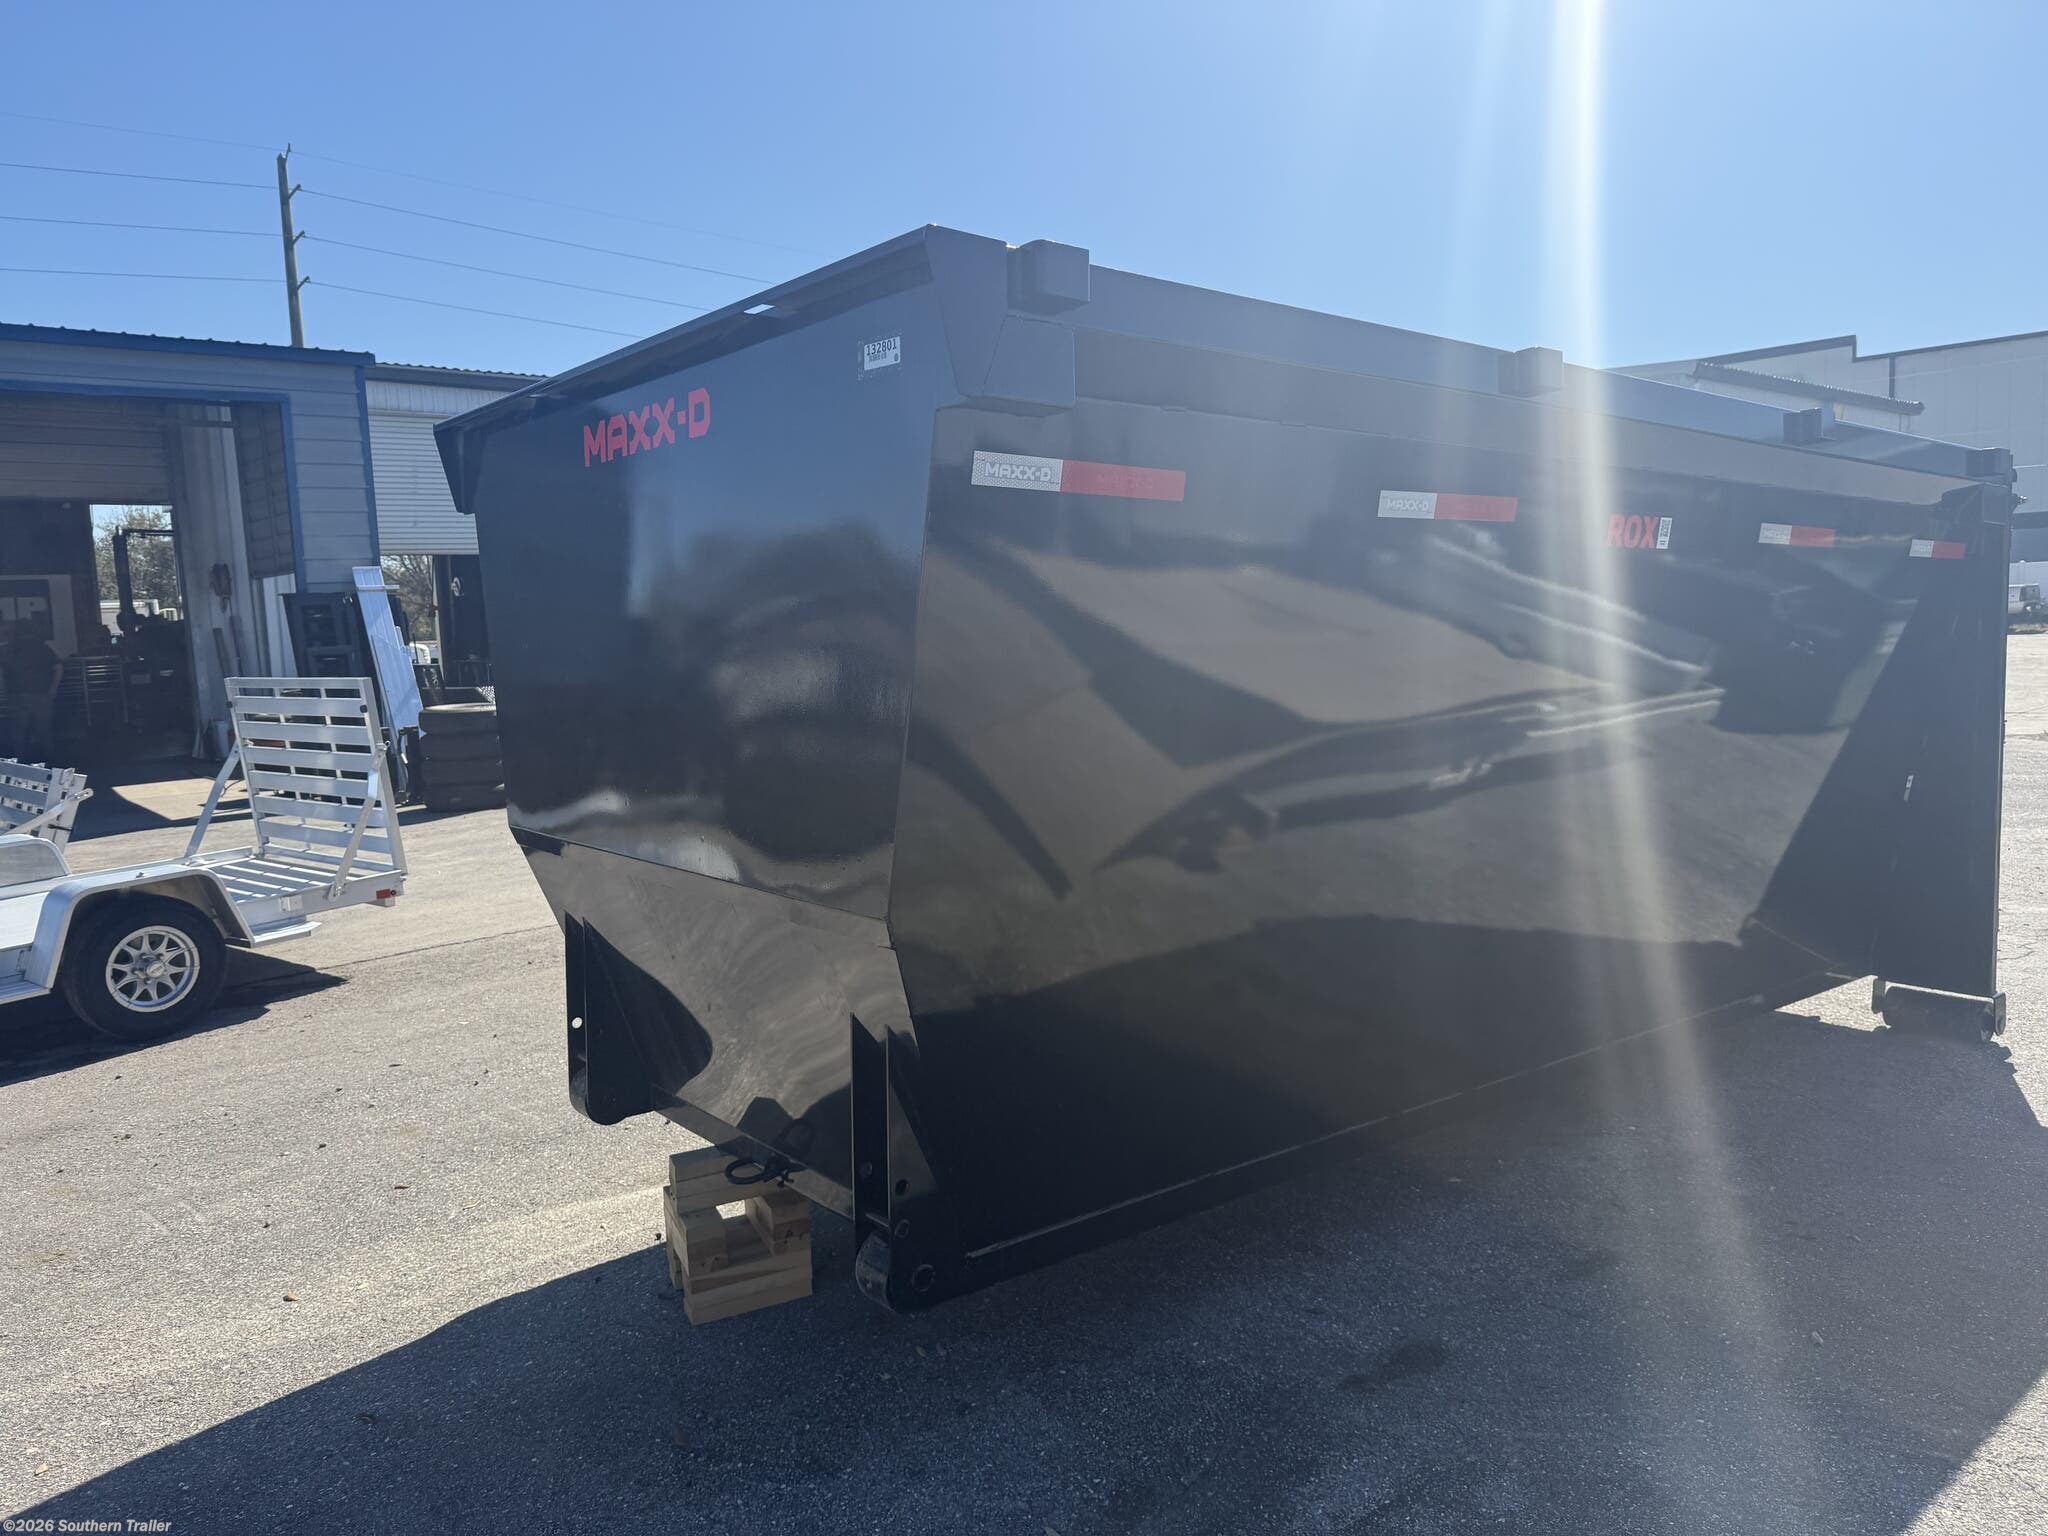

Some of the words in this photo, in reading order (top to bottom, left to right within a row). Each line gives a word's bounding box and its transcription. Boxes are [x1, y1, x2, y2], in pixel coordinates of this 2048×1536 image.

[866, 338, 897, 356] 132801
[583, 387, 711, 467] MAXX-D
[984, 461, 1051, 482] MAXX-D
